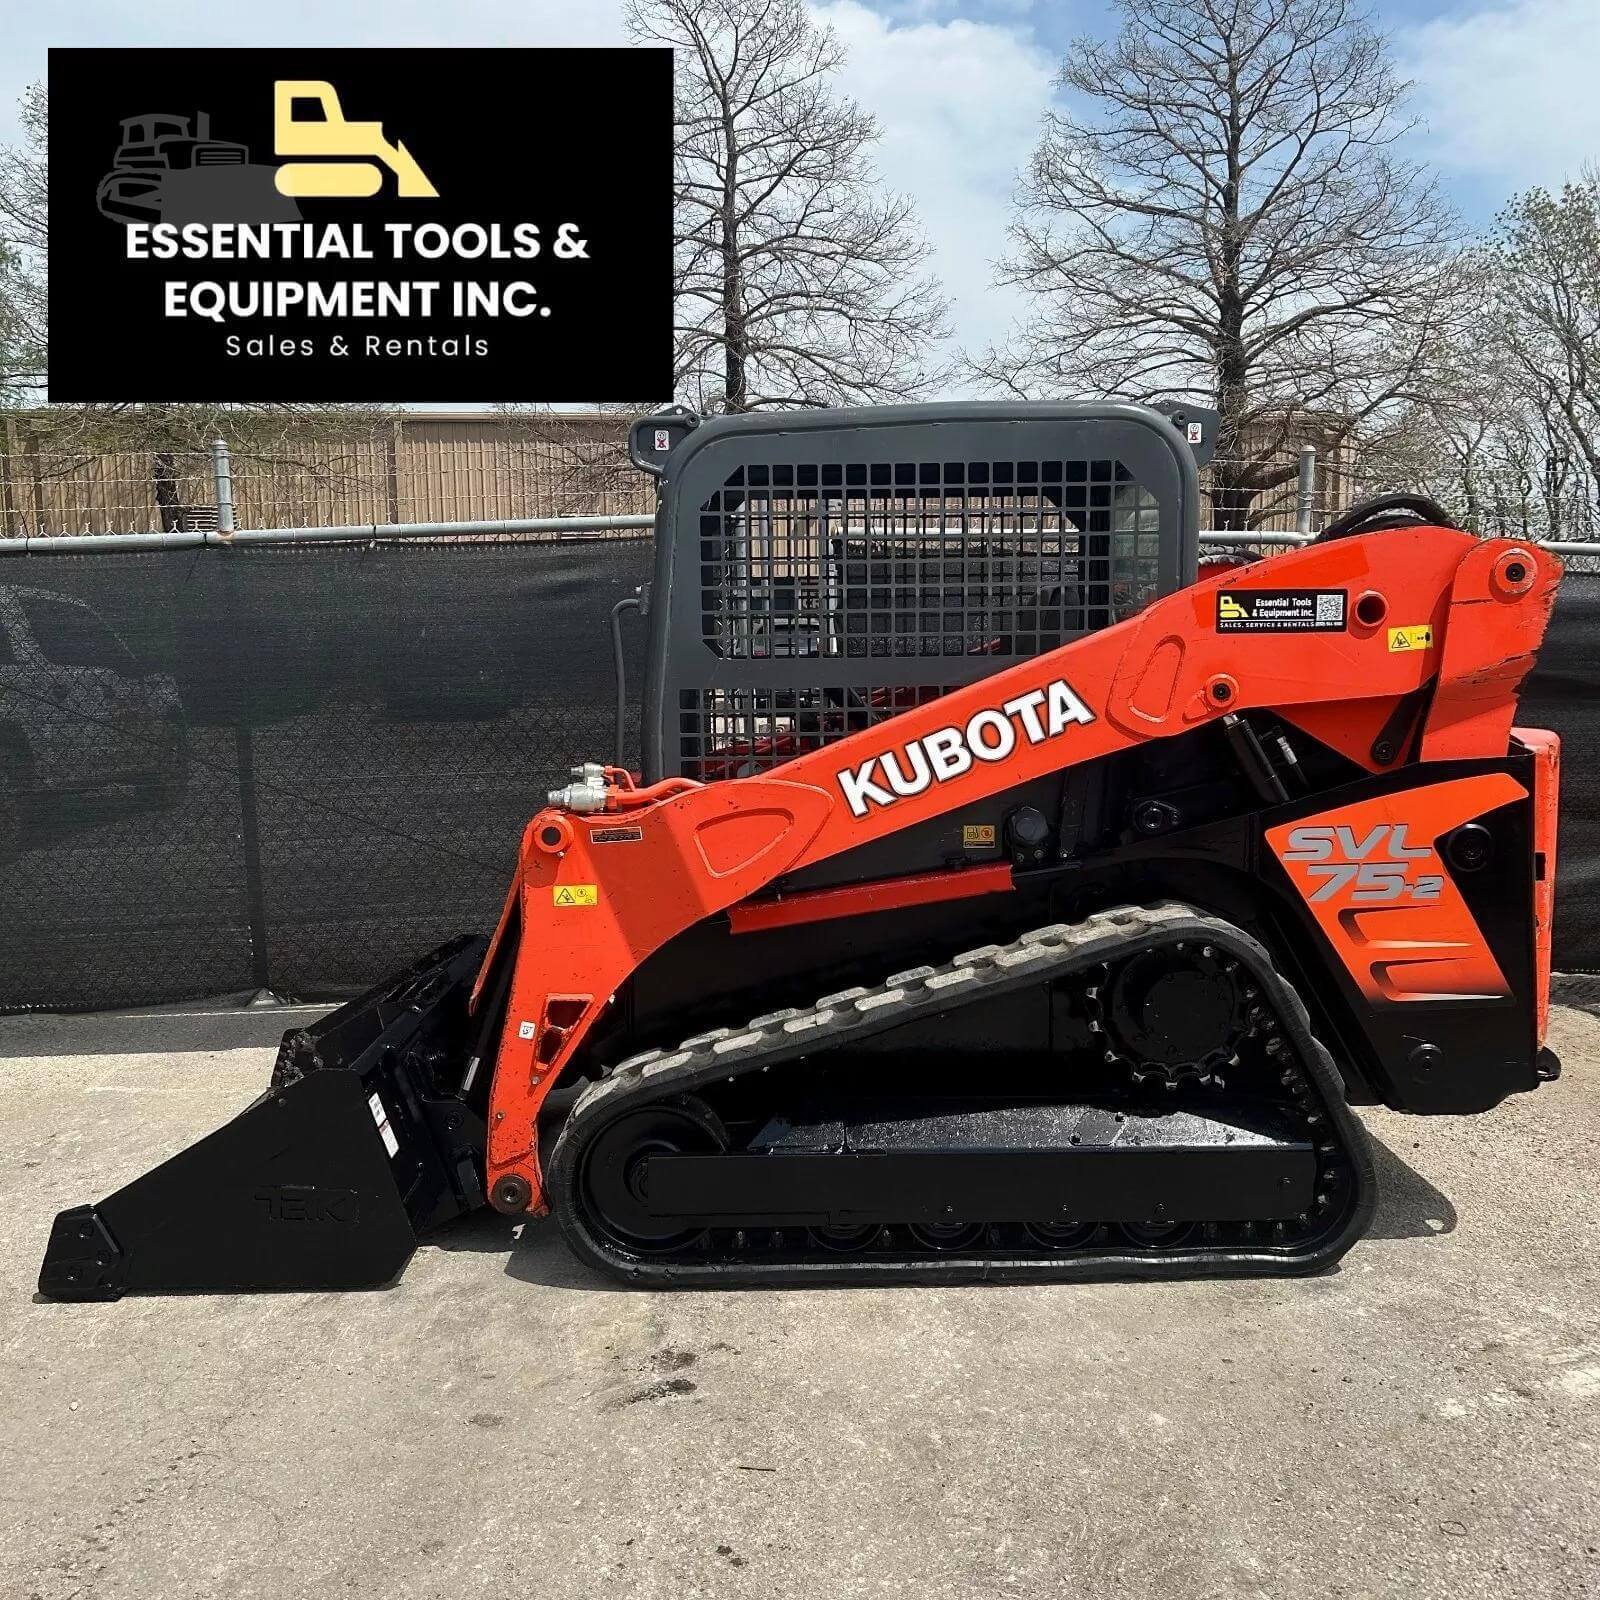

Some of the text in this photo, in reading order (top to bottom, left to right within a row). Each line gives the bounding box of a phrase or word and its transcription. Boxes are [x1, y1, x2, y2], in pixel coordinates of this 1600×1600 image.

[1251, 608, 1315, 618] & Equipment Inc.
[1255, 598, 1312, 607] Essential Tools
[837, 679, 1097, 817] KUBOTA
[1283, 824, 1432, 861] SVL
[1306, 862, 1444, 902] 75-2
